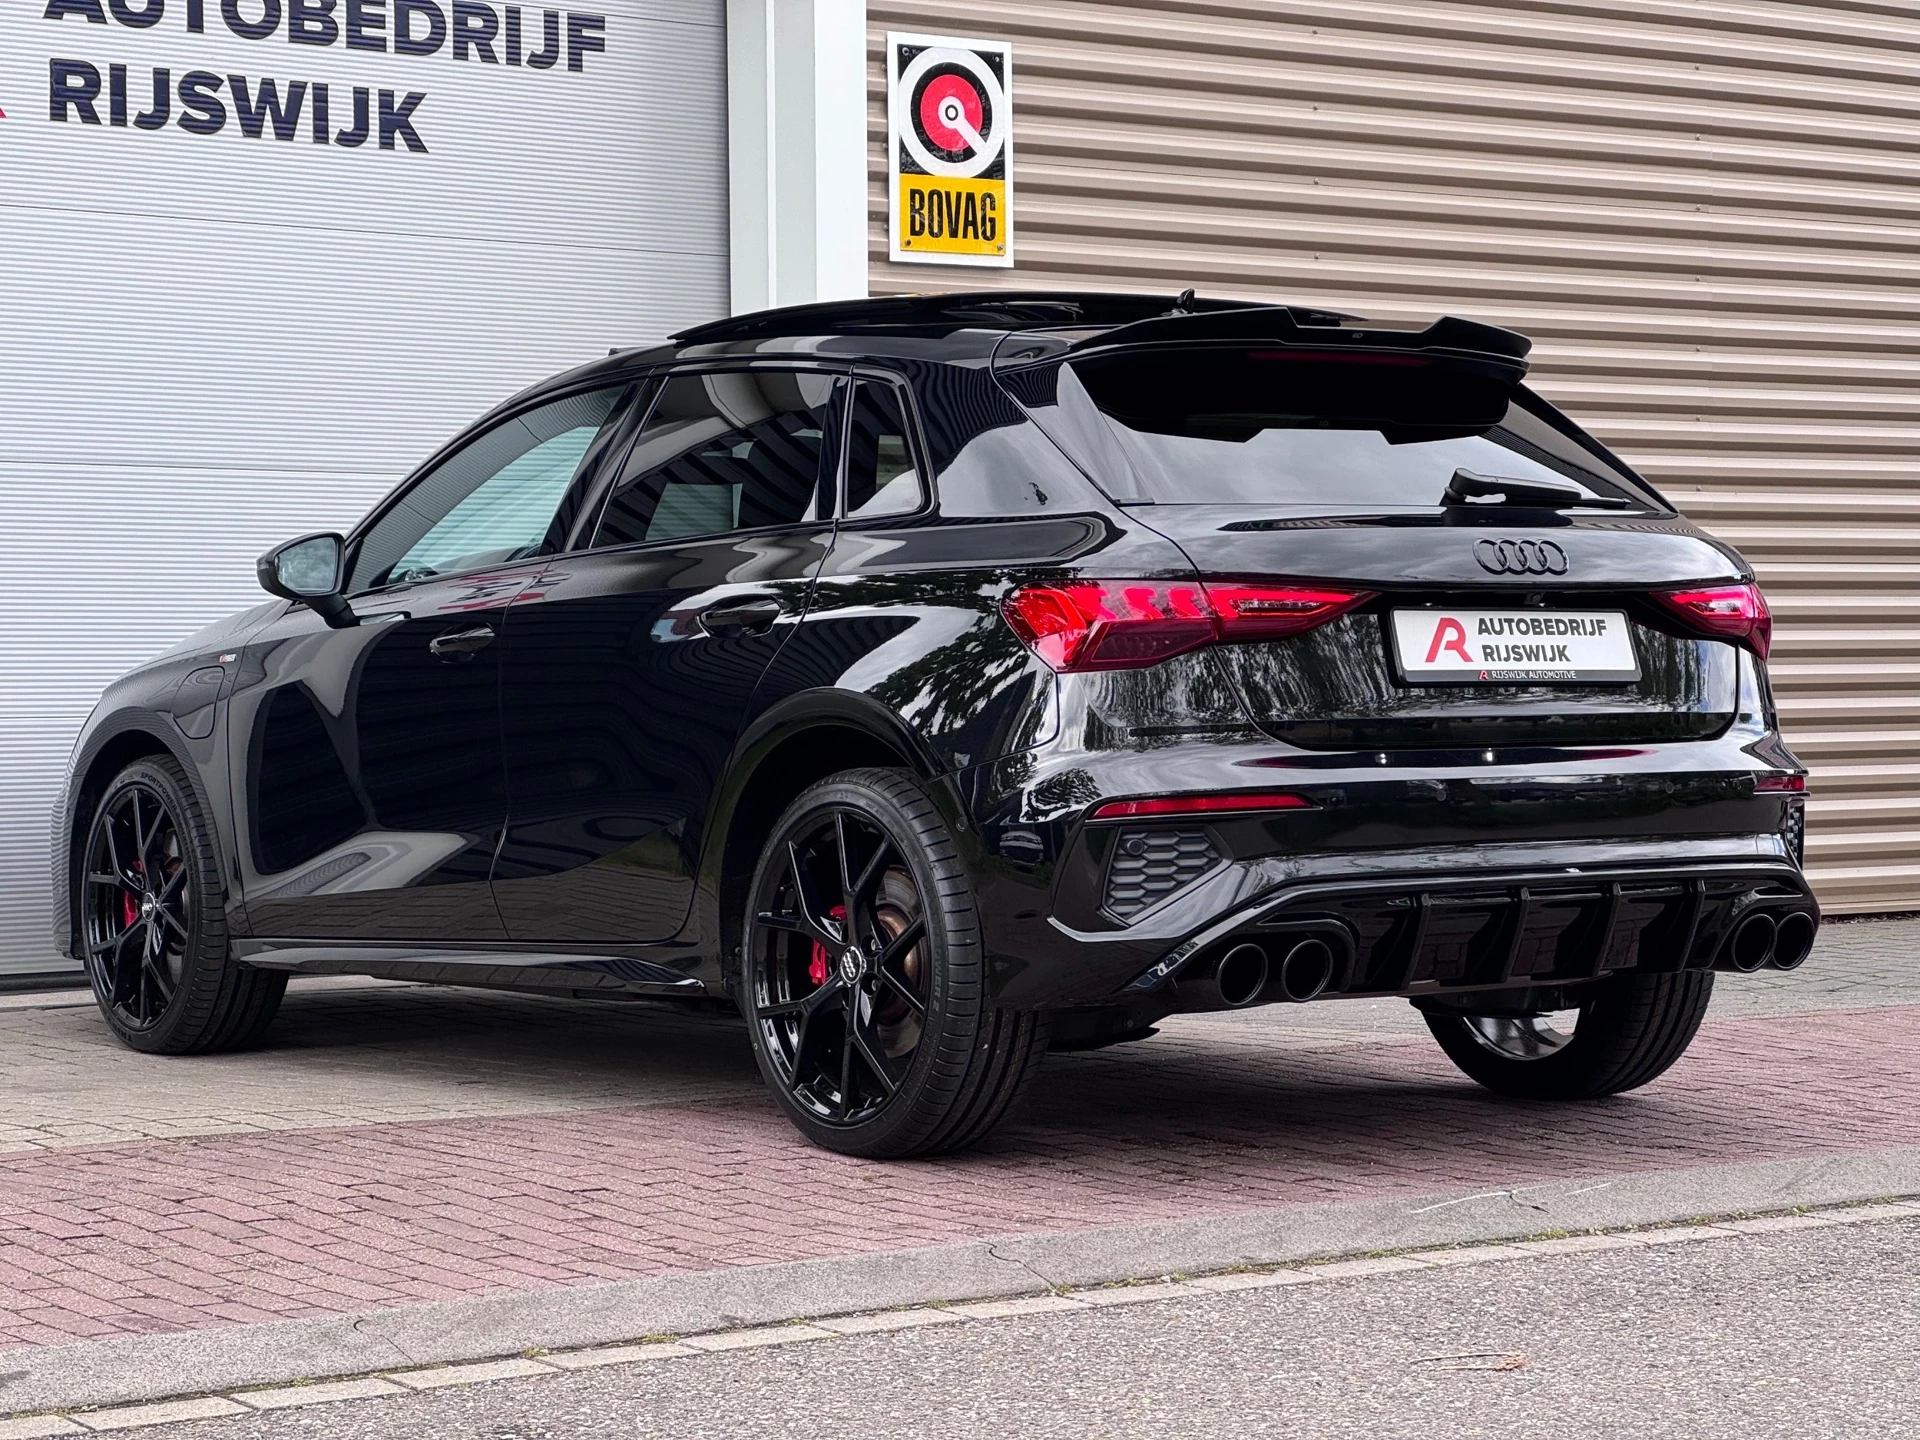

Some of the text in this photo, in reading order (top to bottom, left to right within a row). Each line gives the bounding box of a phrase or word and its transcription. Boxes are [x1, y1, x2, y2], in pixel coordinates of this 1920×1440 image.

[49, 58, 429, 153] RIJSWIJK
[909, 188, 996, 241] BOVAG
[1477, 618, 1607, 637] AUTOBEDRIJF
[1481, 644, 1571, 663] RIJSWIJK
[1491, 670, 1527, 679] RIJSWIJK
[1528, 670, 1577, 679] AUTOMOTIVE
